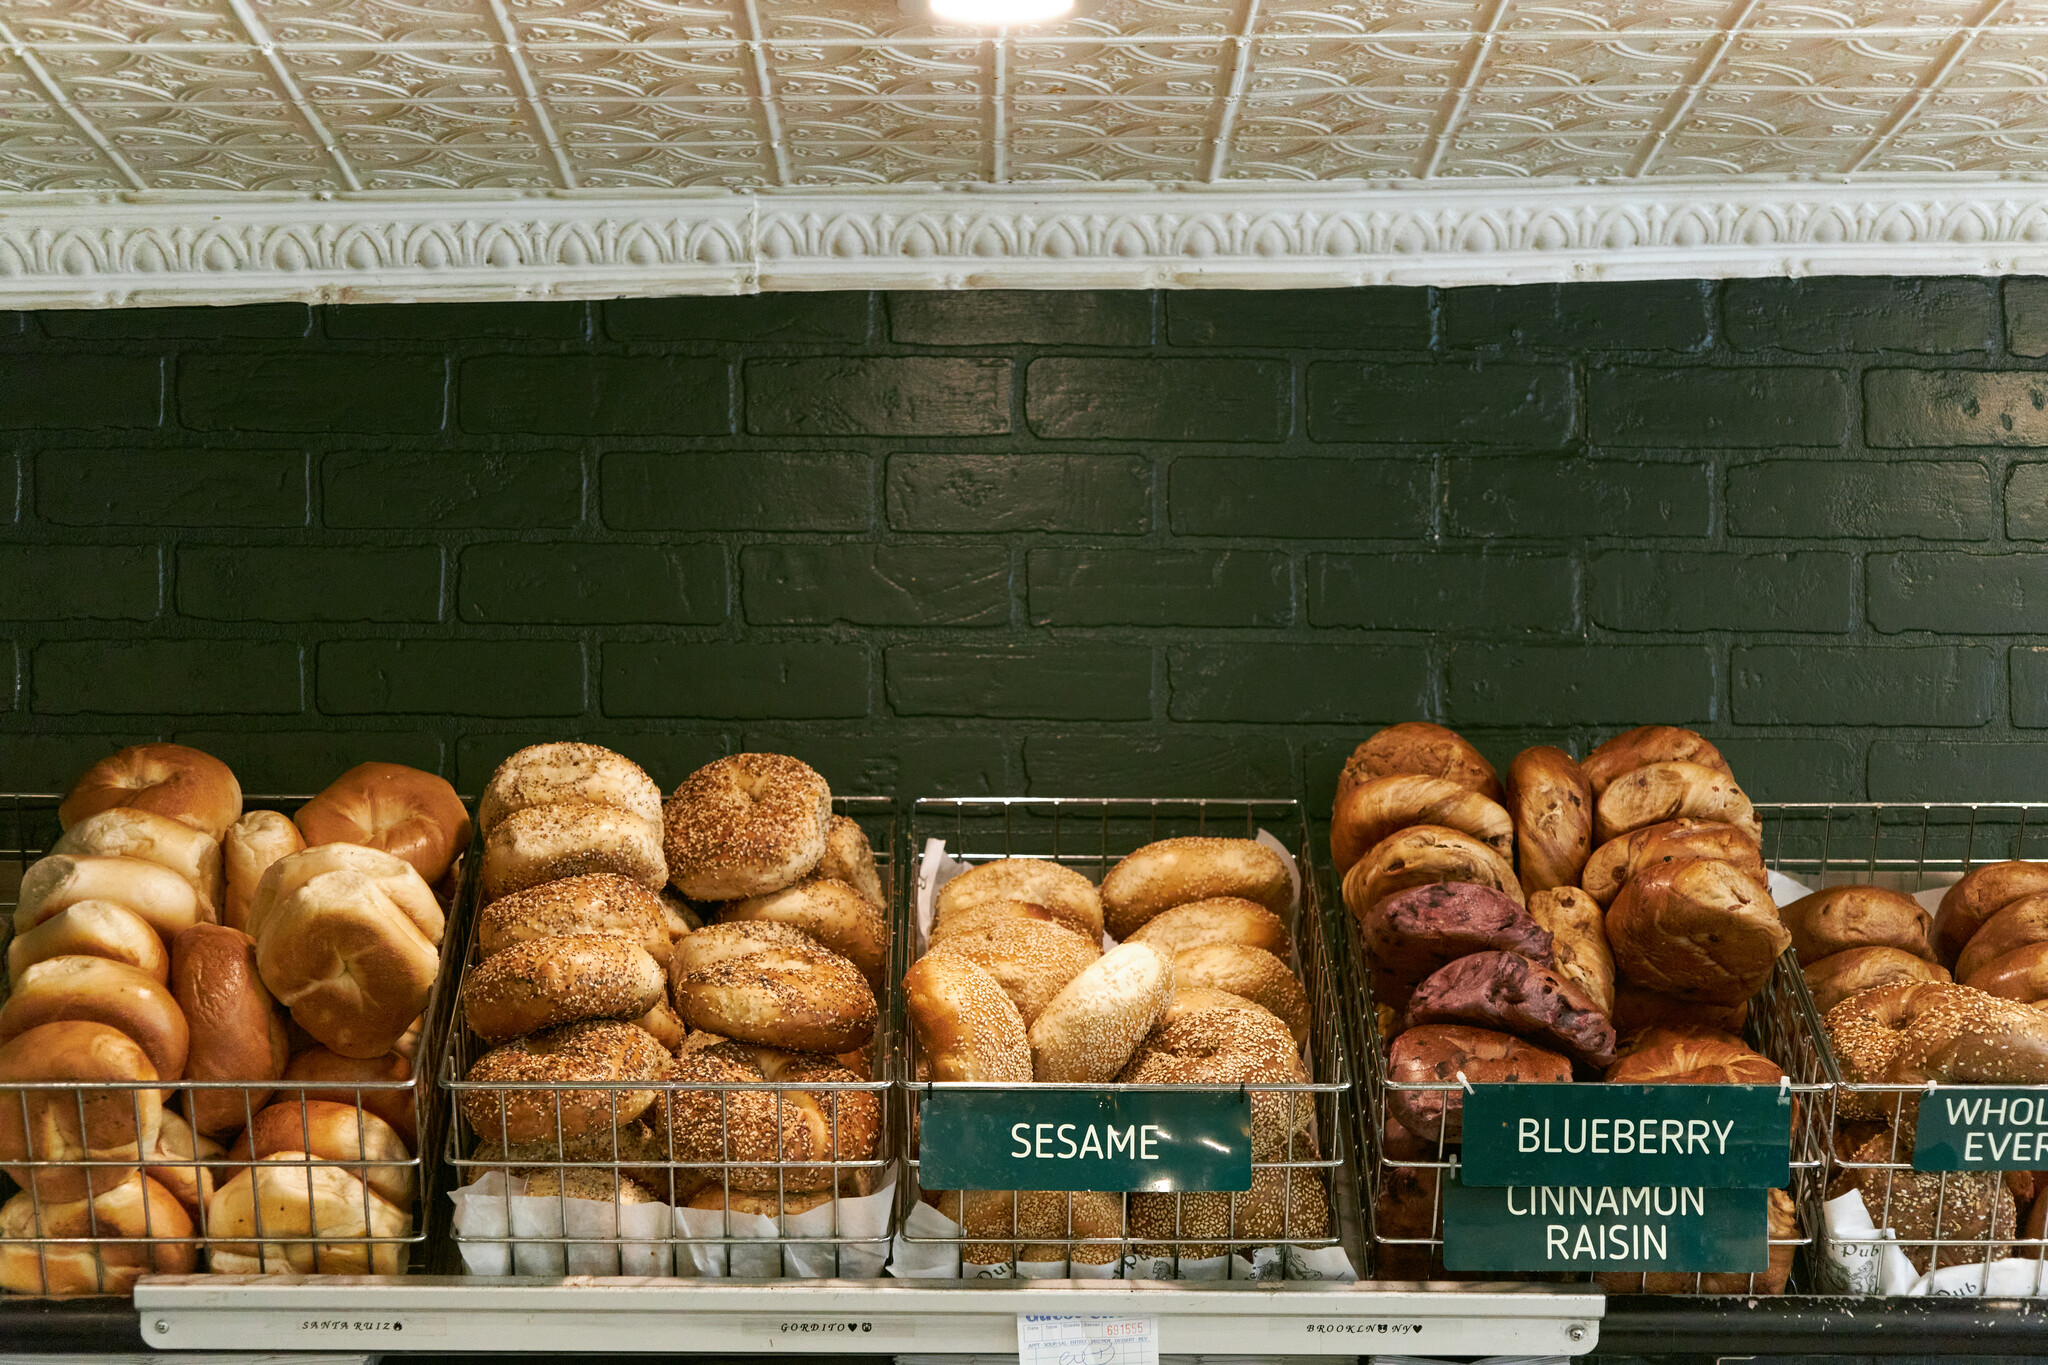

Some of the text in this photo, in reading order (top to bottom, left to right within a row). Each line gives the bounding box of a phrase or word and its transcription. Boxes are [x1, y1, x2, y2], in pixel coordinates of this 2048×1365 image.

[1946, 1097, 2048, 1126] WHOL
[1011, 1123, 1160, 1160] SESAME
[1518, 1117, 1735, 1155] BLUEBERRY
[1507, 1187, 1704, 1216] CINNAMON
[1546, 1224, 1667, 1260] RAISIN
[1842, 1244, 1879, 1258] Pub
[302, 1320, 390, 1331] SANTA RUIZ
[780, 1322, 845, 1333] GORDITO
[1107, 1322, 1143, 1336] 691555
[1306, 1323, 1413, 1335] BROOKLN NY
